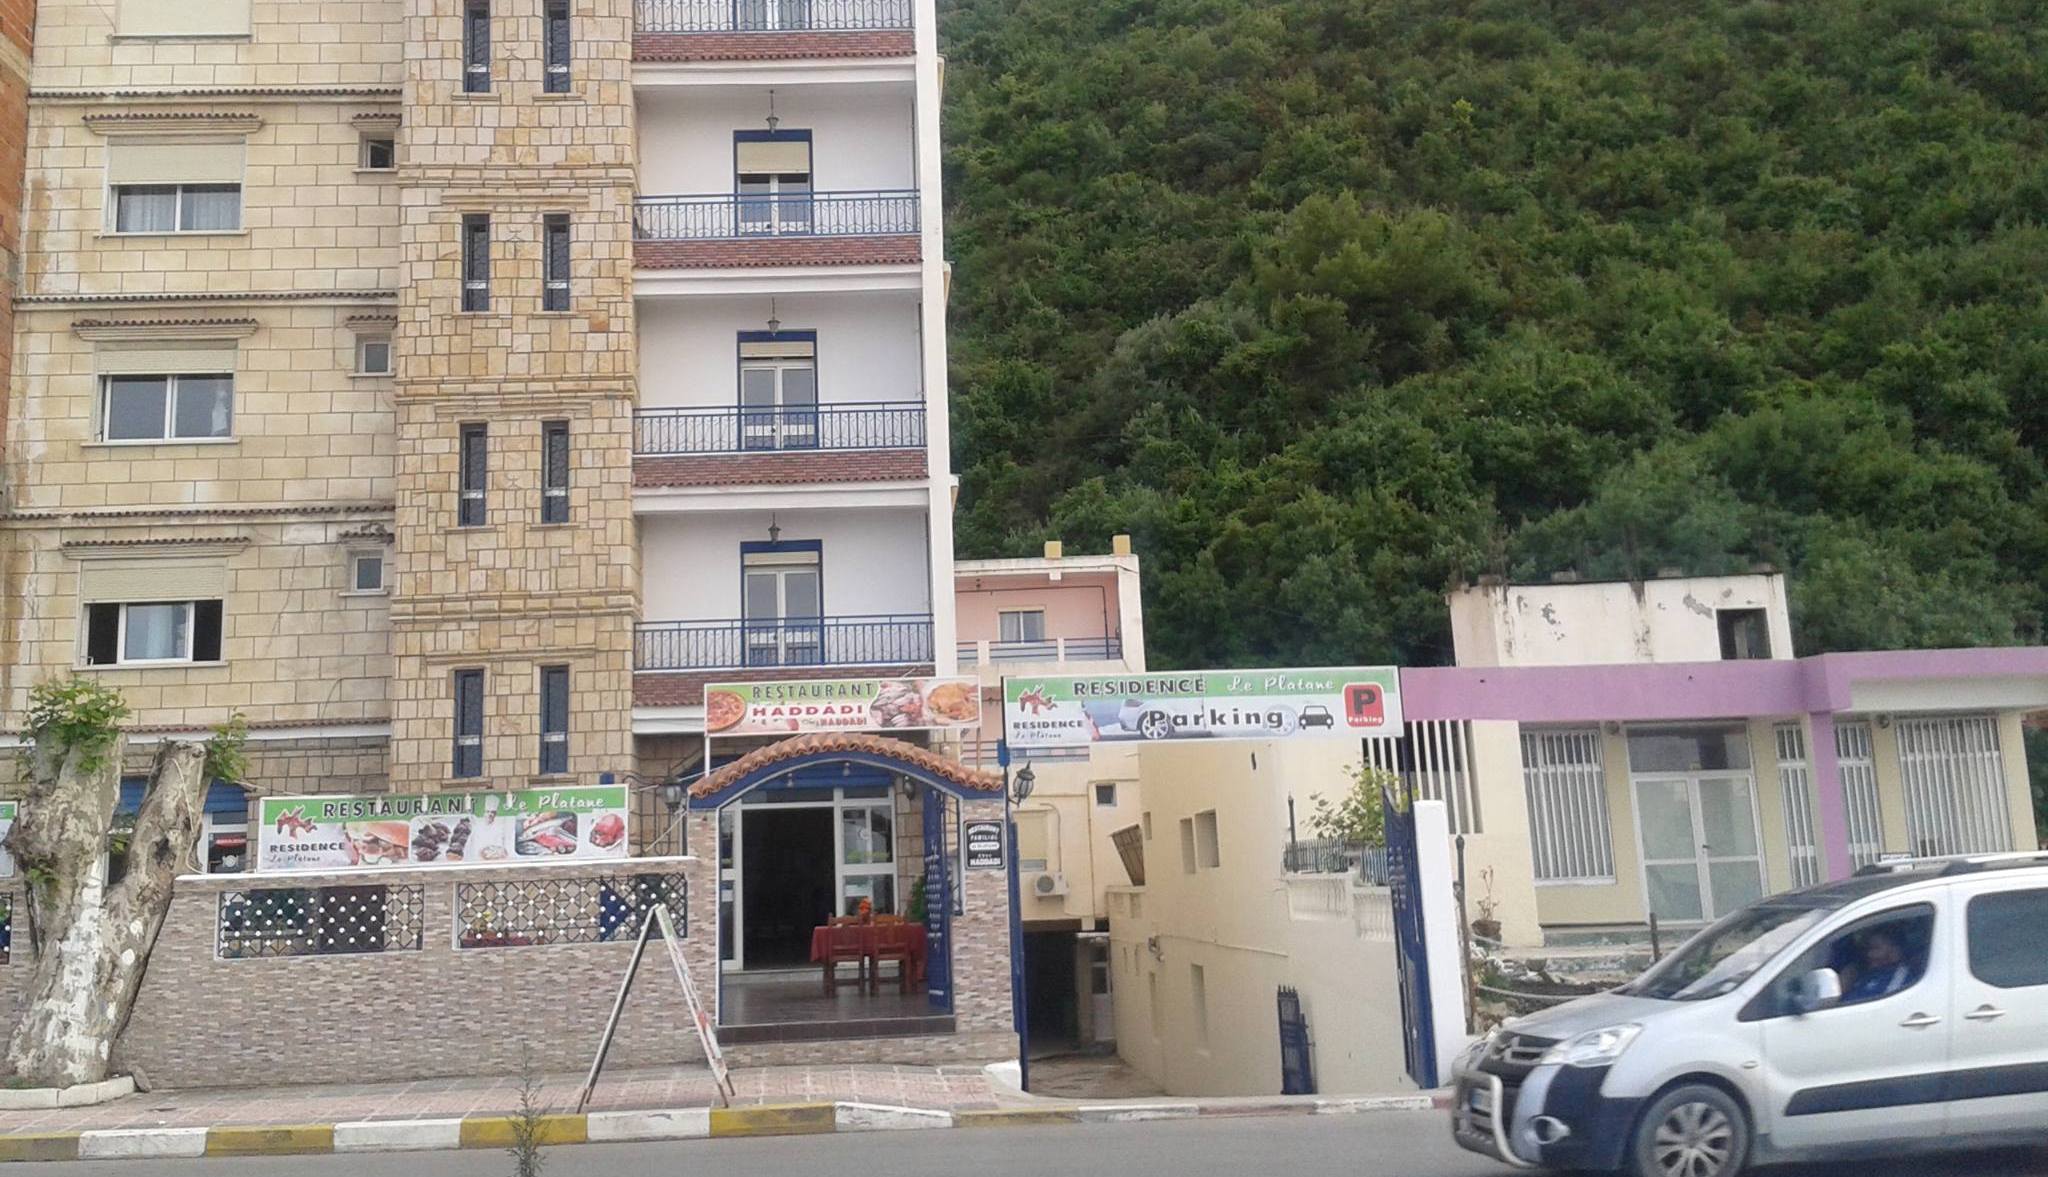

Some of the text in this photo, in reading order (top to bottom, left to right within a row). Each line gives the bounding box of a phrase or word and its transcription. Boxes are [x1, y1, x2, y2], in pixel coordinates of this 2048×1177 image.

[752, 683, 872, 699] RESTAURANT
[1073, 674, 1335, 696] RESIDENCE Le Platane
[1352, 688, 1377, 715] P
[752, 705, 863, 717] HADDADI
[1149, 708, 1284, 729] Parking
[1012, 719, 1084, 730] RESIDENCE
[1347, 715, 1384, 725] Parking
[323, 797, 476, 817] RESTAURANT
[538, 791, 606, 810] Platane
[269, 842, 345, 853] RESIDENCE
